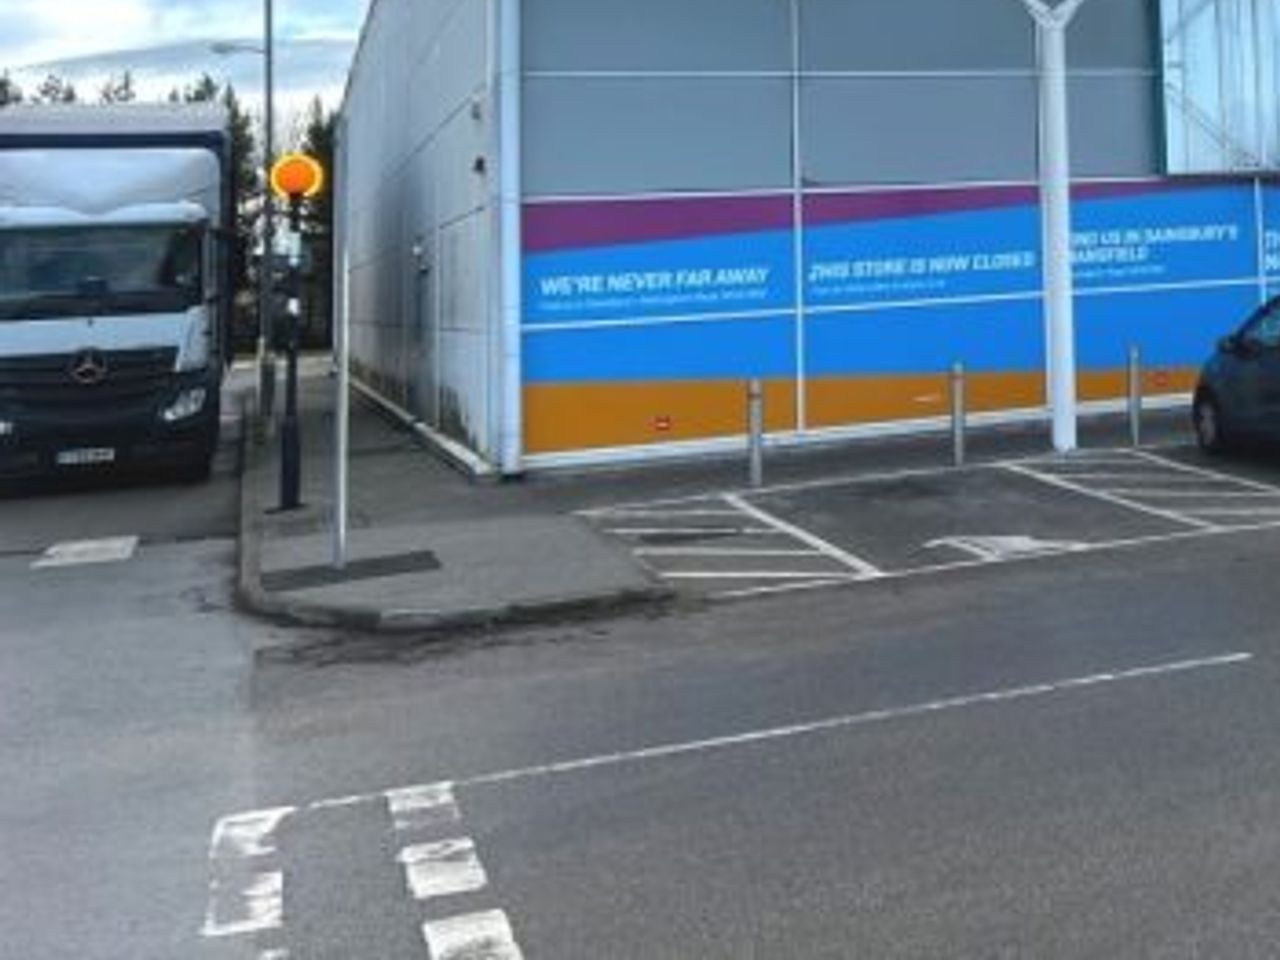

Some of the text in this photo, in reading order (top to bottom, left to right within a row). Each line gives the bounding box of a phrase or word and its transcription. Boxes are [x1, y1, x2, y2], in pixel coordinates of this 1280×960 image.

[1143, 224, 1238, 243] SAINSBURY'S
[808, 250, 1037, 282] THIS STORE IS NOW CLOSED
[541, 268, 769, 296] WE'RE NEVER FAR AWAY
